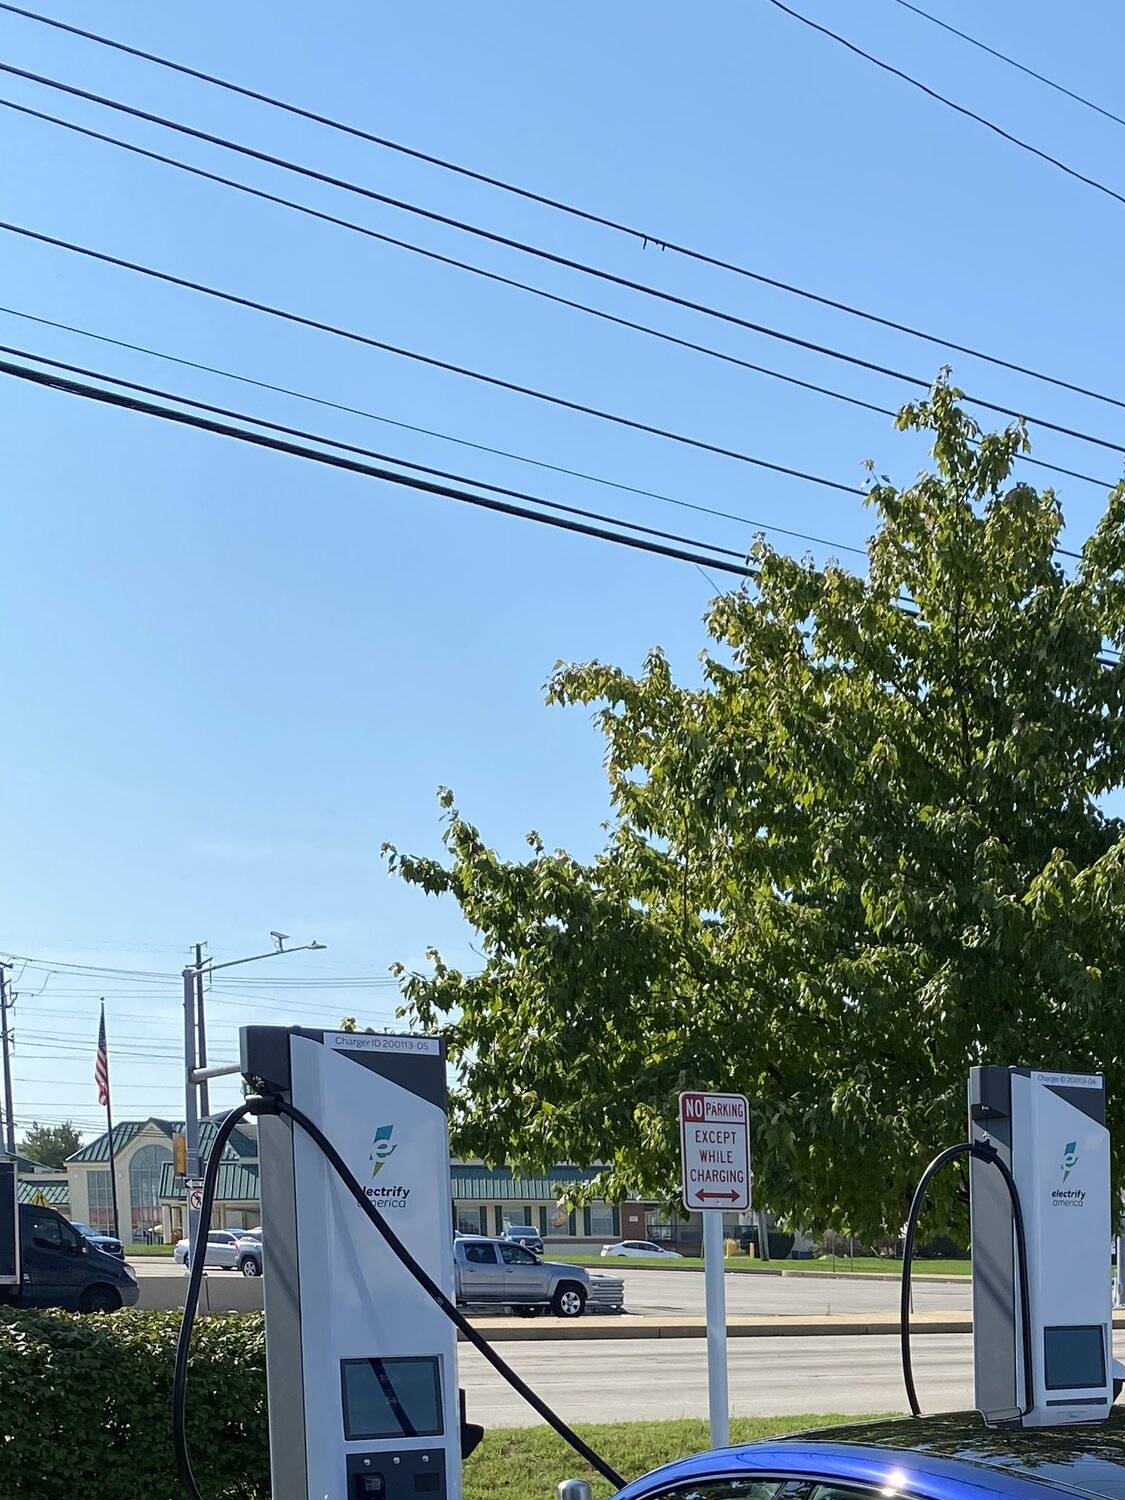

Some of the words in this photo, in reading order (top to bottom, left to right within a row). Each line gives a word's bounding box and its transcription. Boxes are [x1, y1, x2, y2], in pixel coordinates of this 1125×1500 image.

[335, 1036, 370, 1048] Charger
[371, 1039, 381, 1048] ID
[383, 1040, 429, 1050] 200113-05
[685, 1098, 703, 1118] NO
[705, 1102, 744, 1118] PARKING
[695, 1130, 736, 1144] EXCEPT
[699, 1149, 734, 1164] WHILE
[690, 1168, 744, 1183] CHARGING
[362, 1185, 411, 1200] lectrify
[1051, 1189, 1087, 1201] electrify
[1052, 1199, 1084, 1208] america
